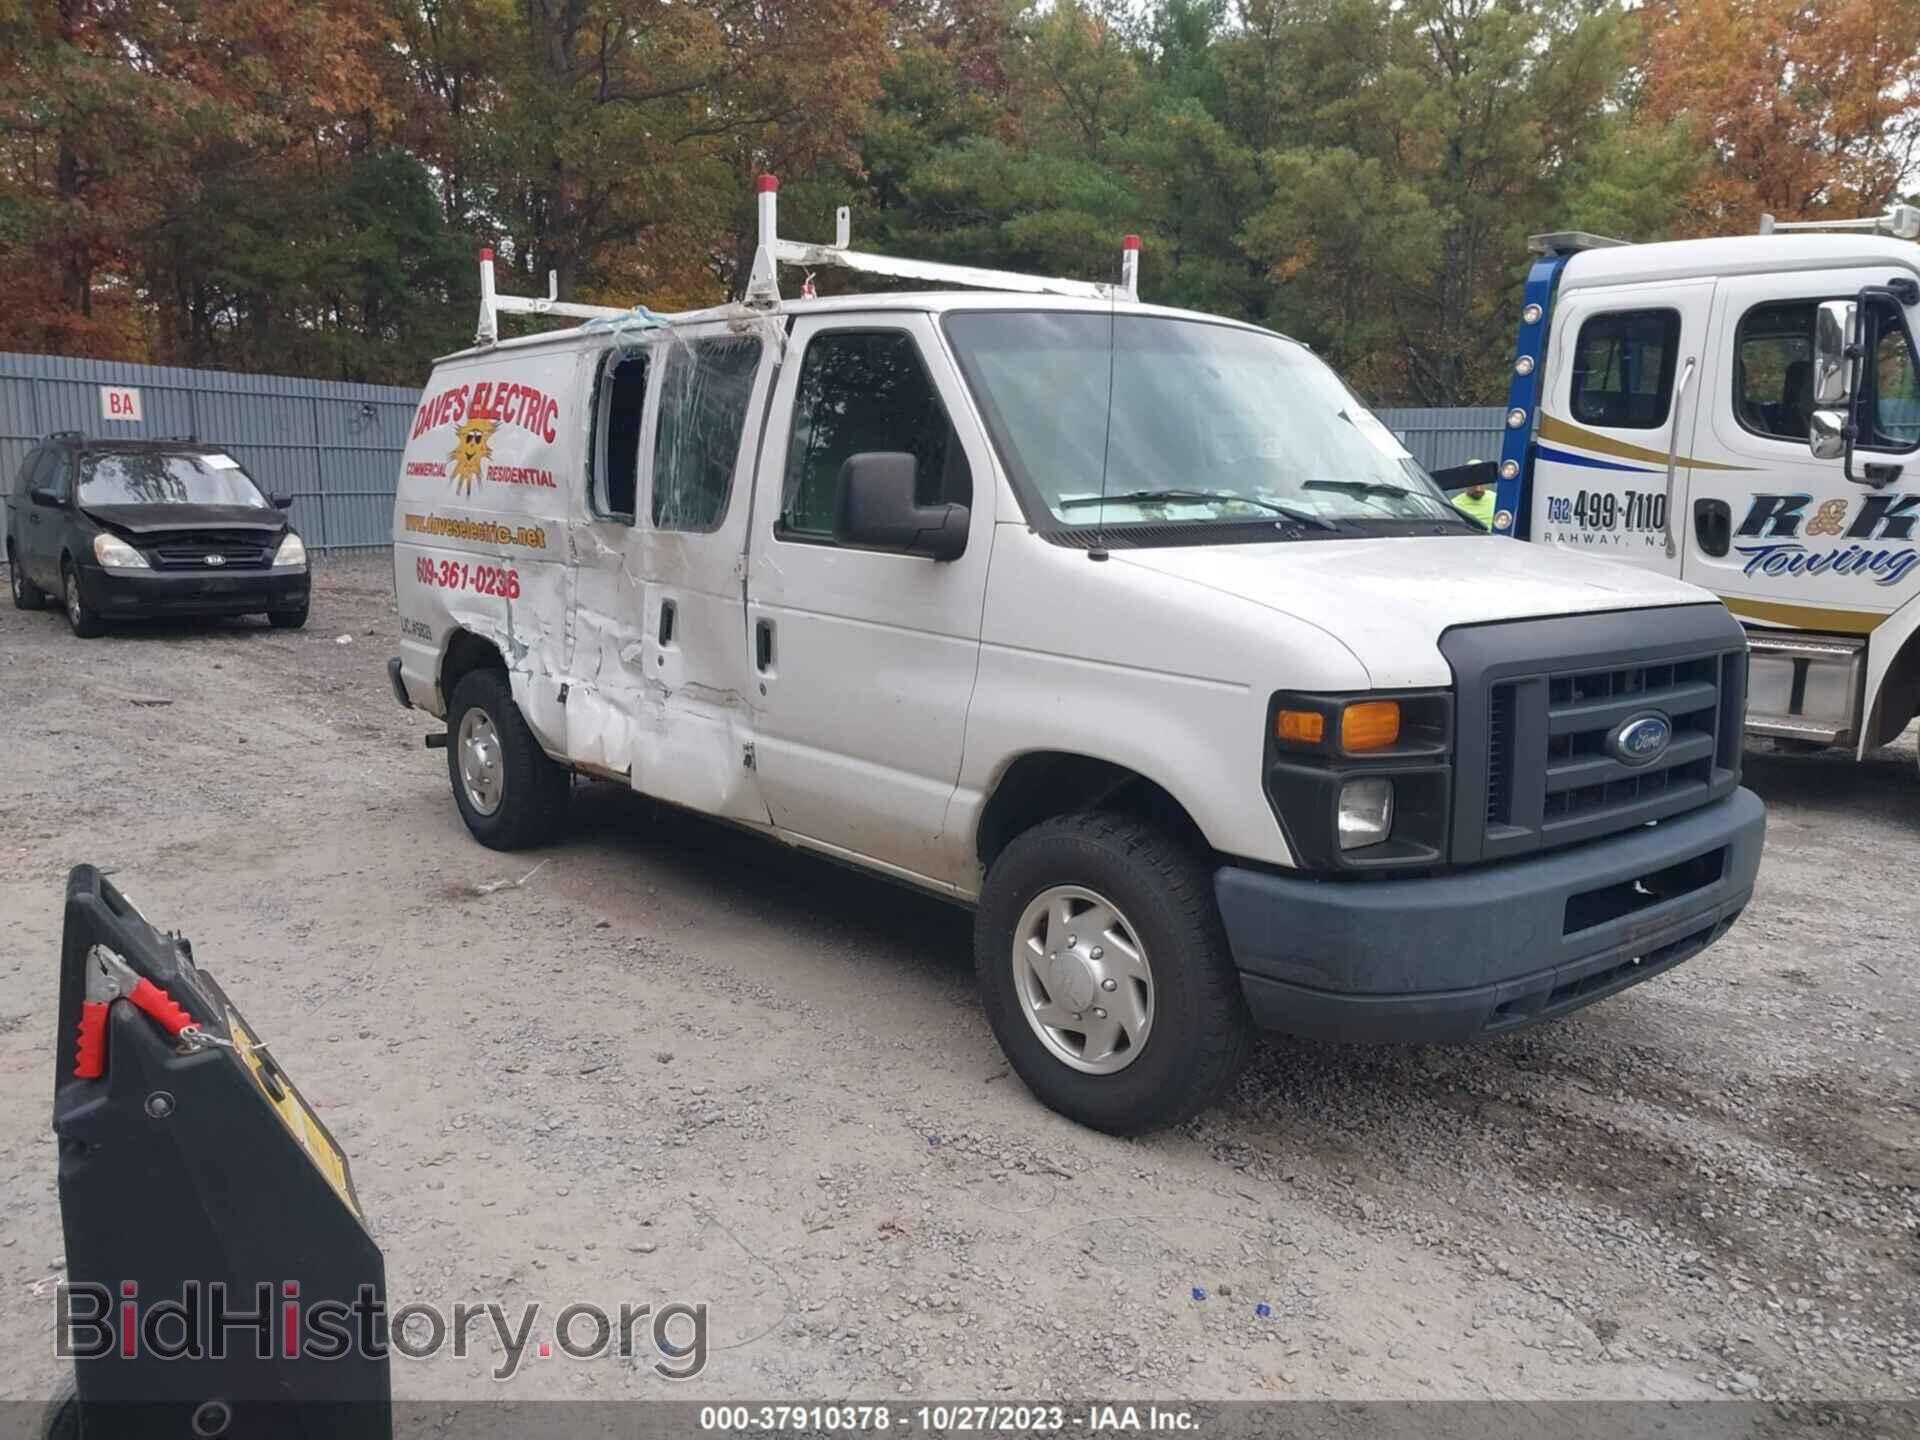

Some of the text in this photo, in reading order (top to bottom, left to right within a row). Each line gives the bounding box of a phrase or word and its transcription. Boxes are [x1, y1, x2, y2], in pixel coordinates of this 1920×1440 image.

[109, 392, 134, 415] BA
[412, 381, 558, 444] DAVE'S ELECTRIC
[406, 461, 447, 478] COMMERCIAL
[486, 465, 557, 488] RESIDENTIAL
[1546, 496, 1572, 524] 732
[404, 512, 546, 549] www.daveselectric.net
[1543, 531, 1667, 548] RAHWAY, NJ
[416, 556, 521, 600] 609-361-0236
[1733, 543, 1920, 588] Towing
